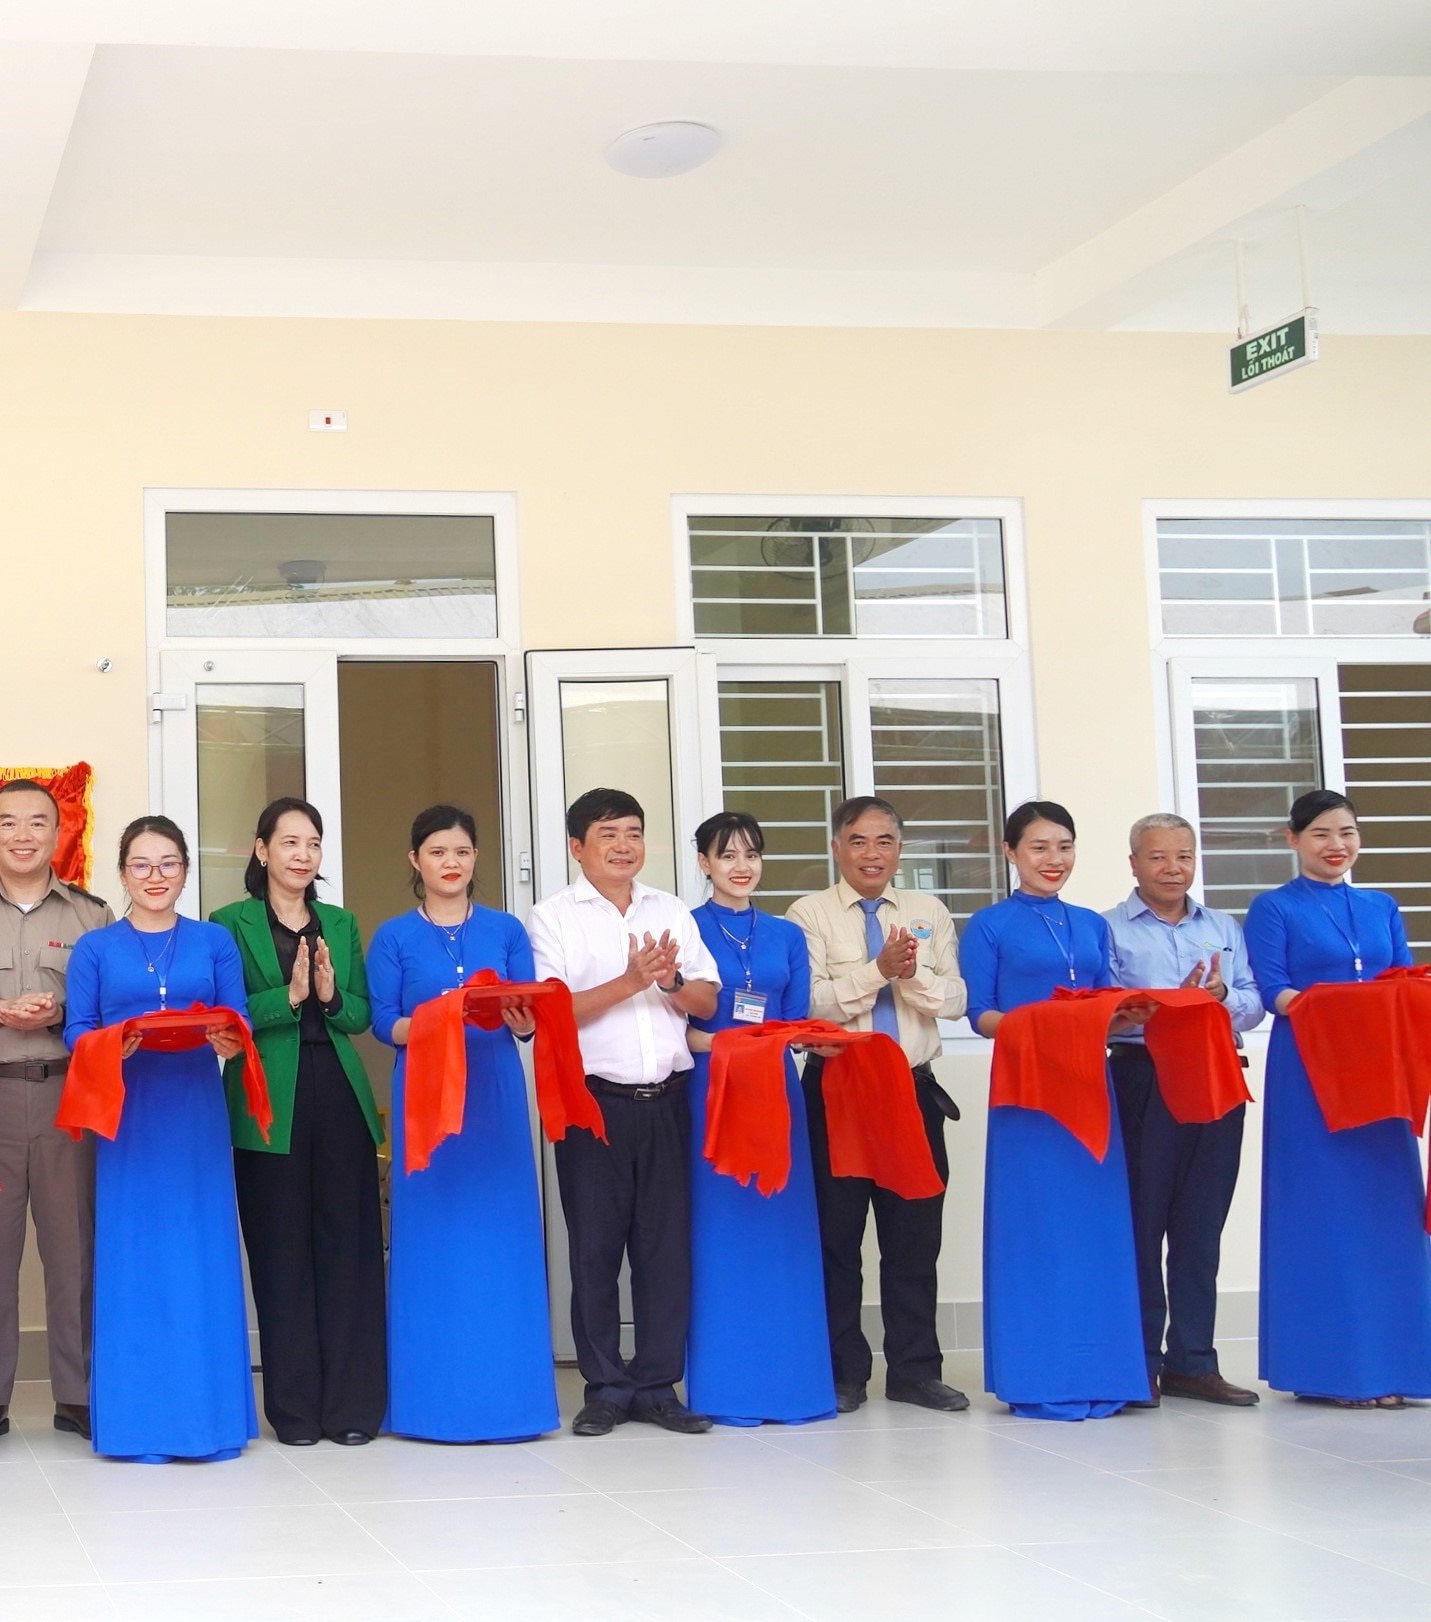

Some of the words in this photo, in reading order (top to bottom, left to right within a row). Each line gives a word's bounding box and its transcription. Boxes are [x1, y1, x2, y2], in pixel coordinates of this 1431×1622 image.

[1246, 327, 1289, 361] EXIT
[1241, 358, 1259, 380] LỐI
[1261, 346, 1295, 371] THOÁT
